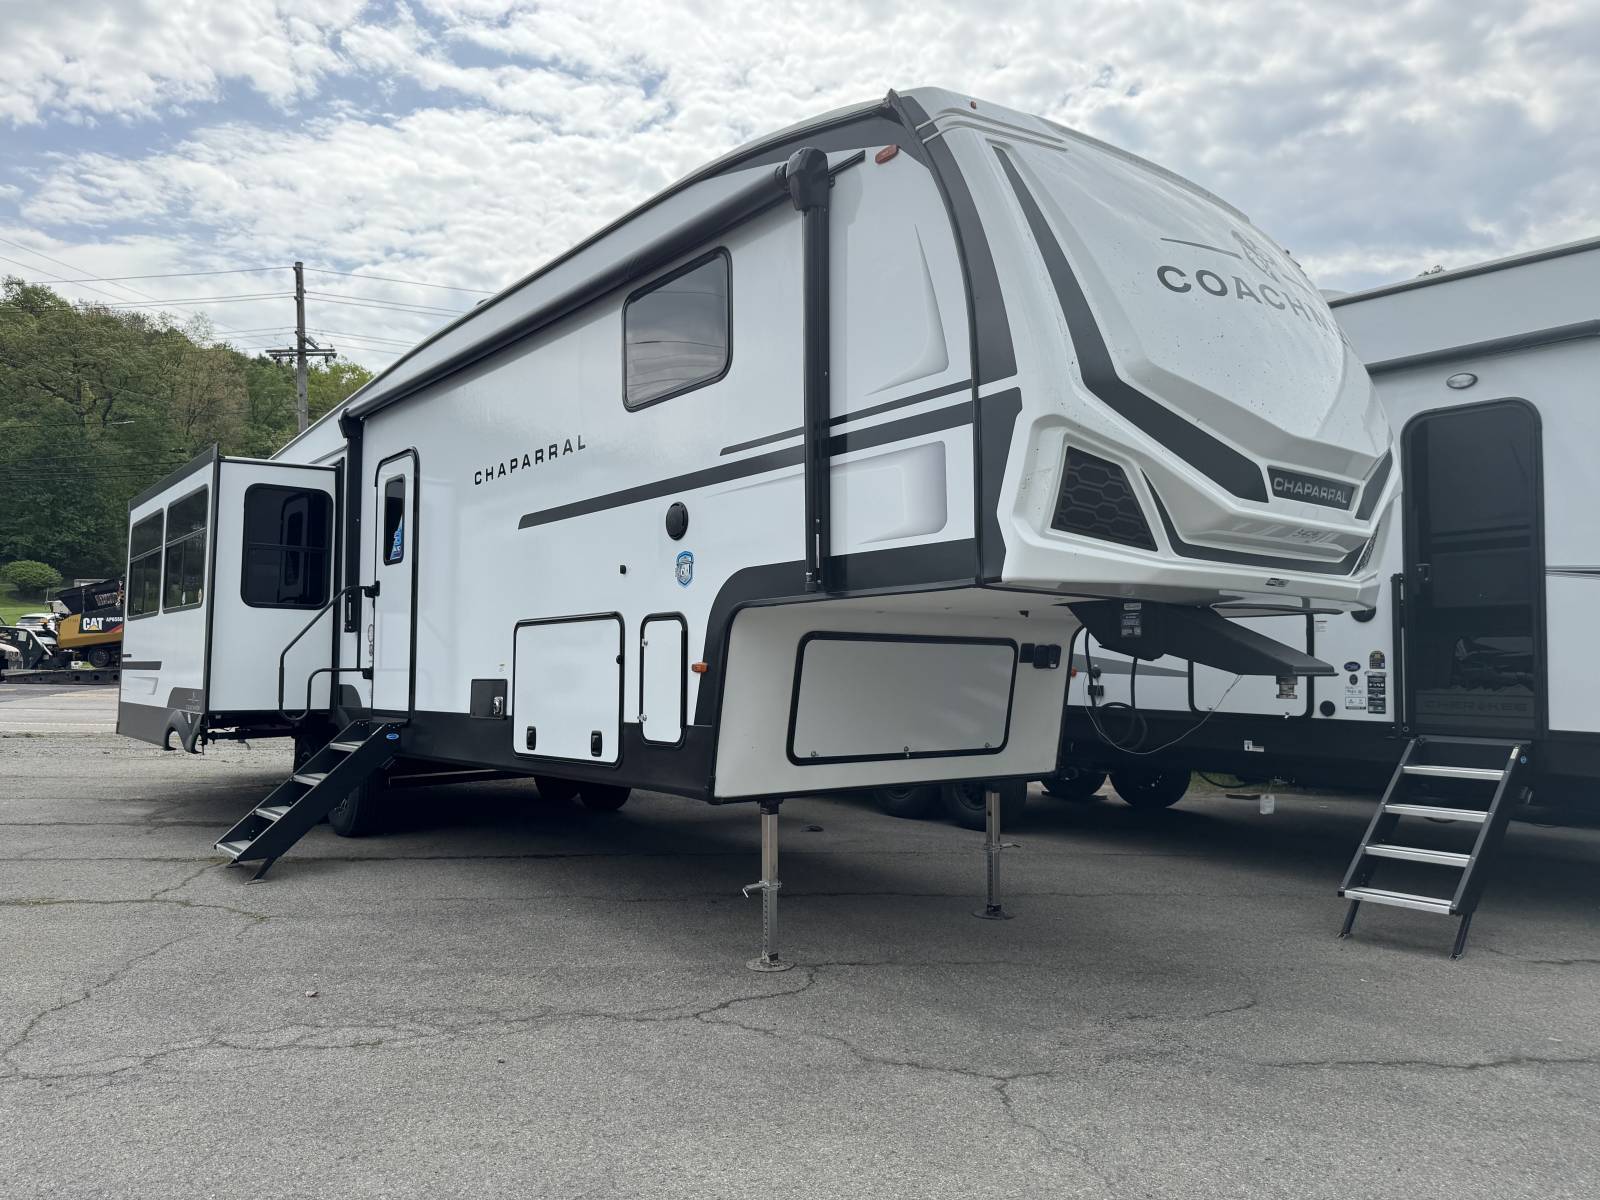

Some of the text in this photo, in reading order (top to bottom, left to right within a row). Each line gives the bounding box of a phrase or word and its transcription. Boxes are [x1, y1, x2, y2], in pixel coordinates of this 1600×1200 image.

[474, 434, 587, 486] CHAPARRAL
[1273, 478, 1348, 503] CHAPARRAL
[83, 618, 104, 630] CAT
